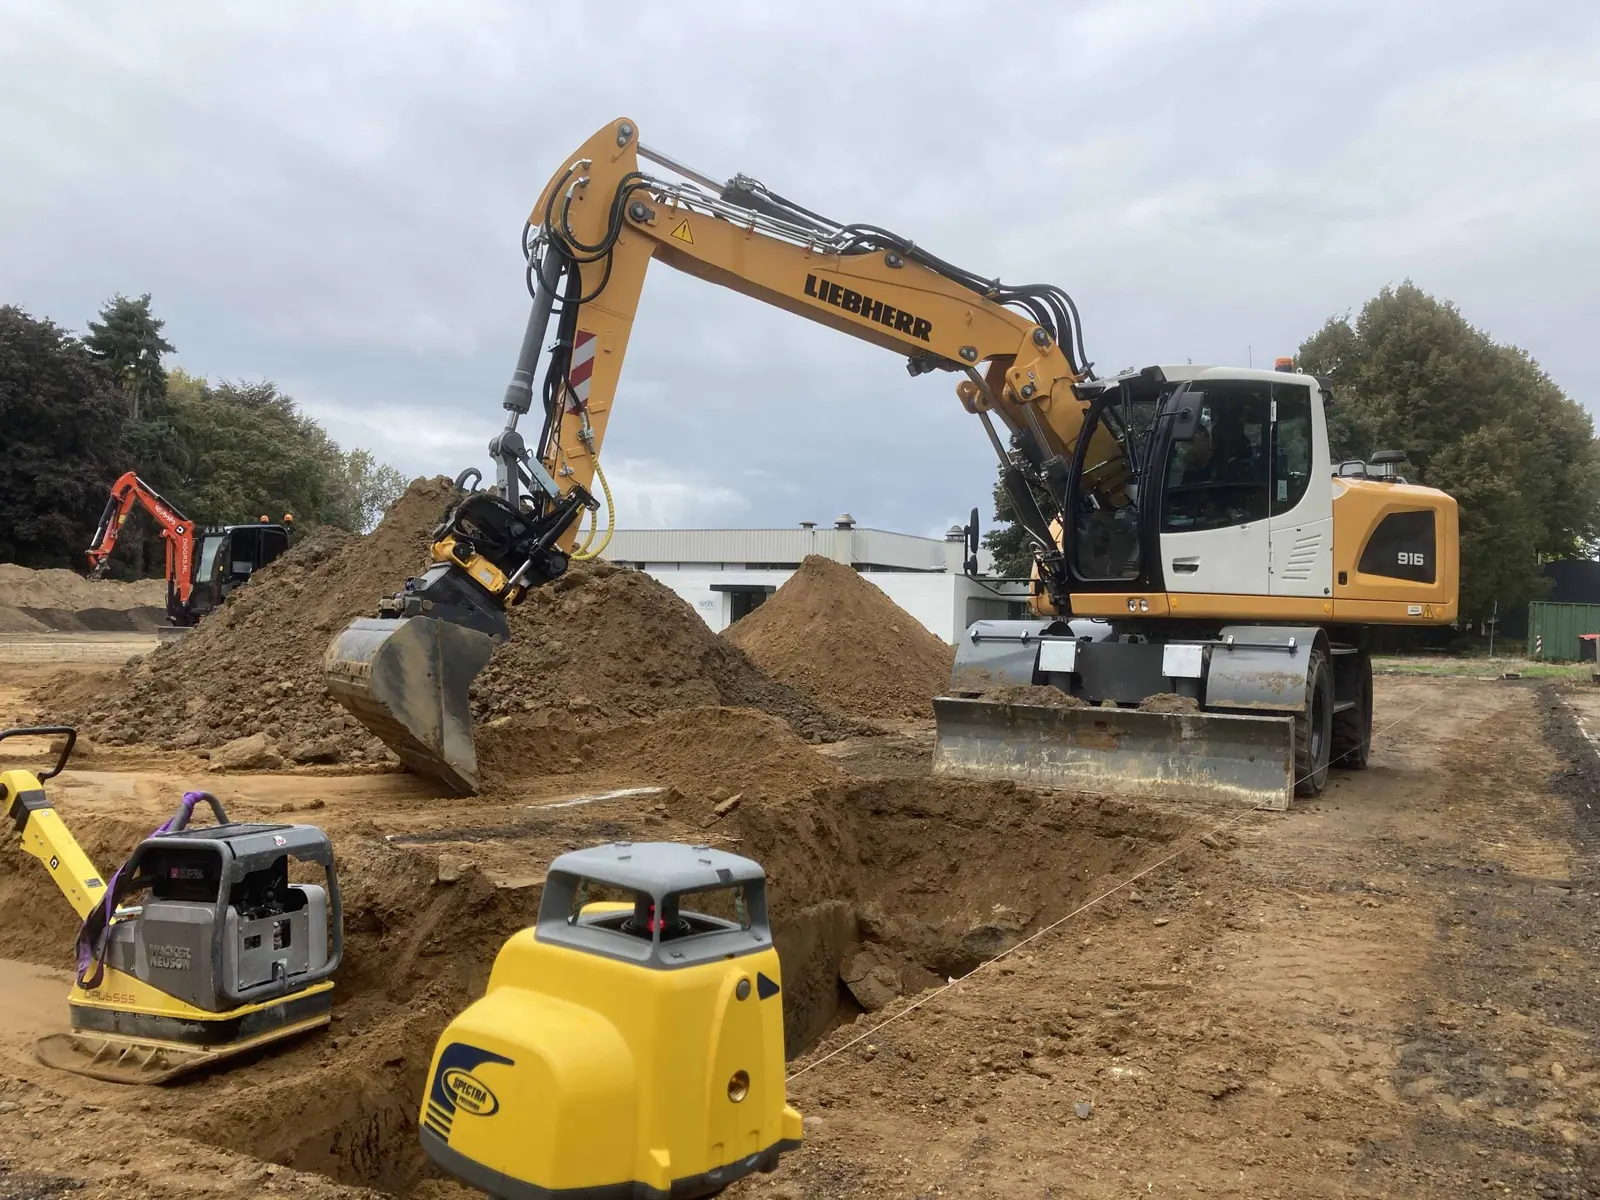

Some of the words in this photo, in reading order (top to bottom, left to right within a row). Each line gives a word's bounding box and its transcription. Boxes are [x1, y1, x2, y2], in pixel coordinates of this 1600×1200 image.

[804, 273, 933, 342] LIEBHERR
[155, 505, 176, 525] Kubota
[1397, 551, 1424, 566] 916
[149, 944, 191, 958] WACKER
[150, 956, 190, 970] NEUSON
[452, 1077, 487, 1104] SPECTRA
